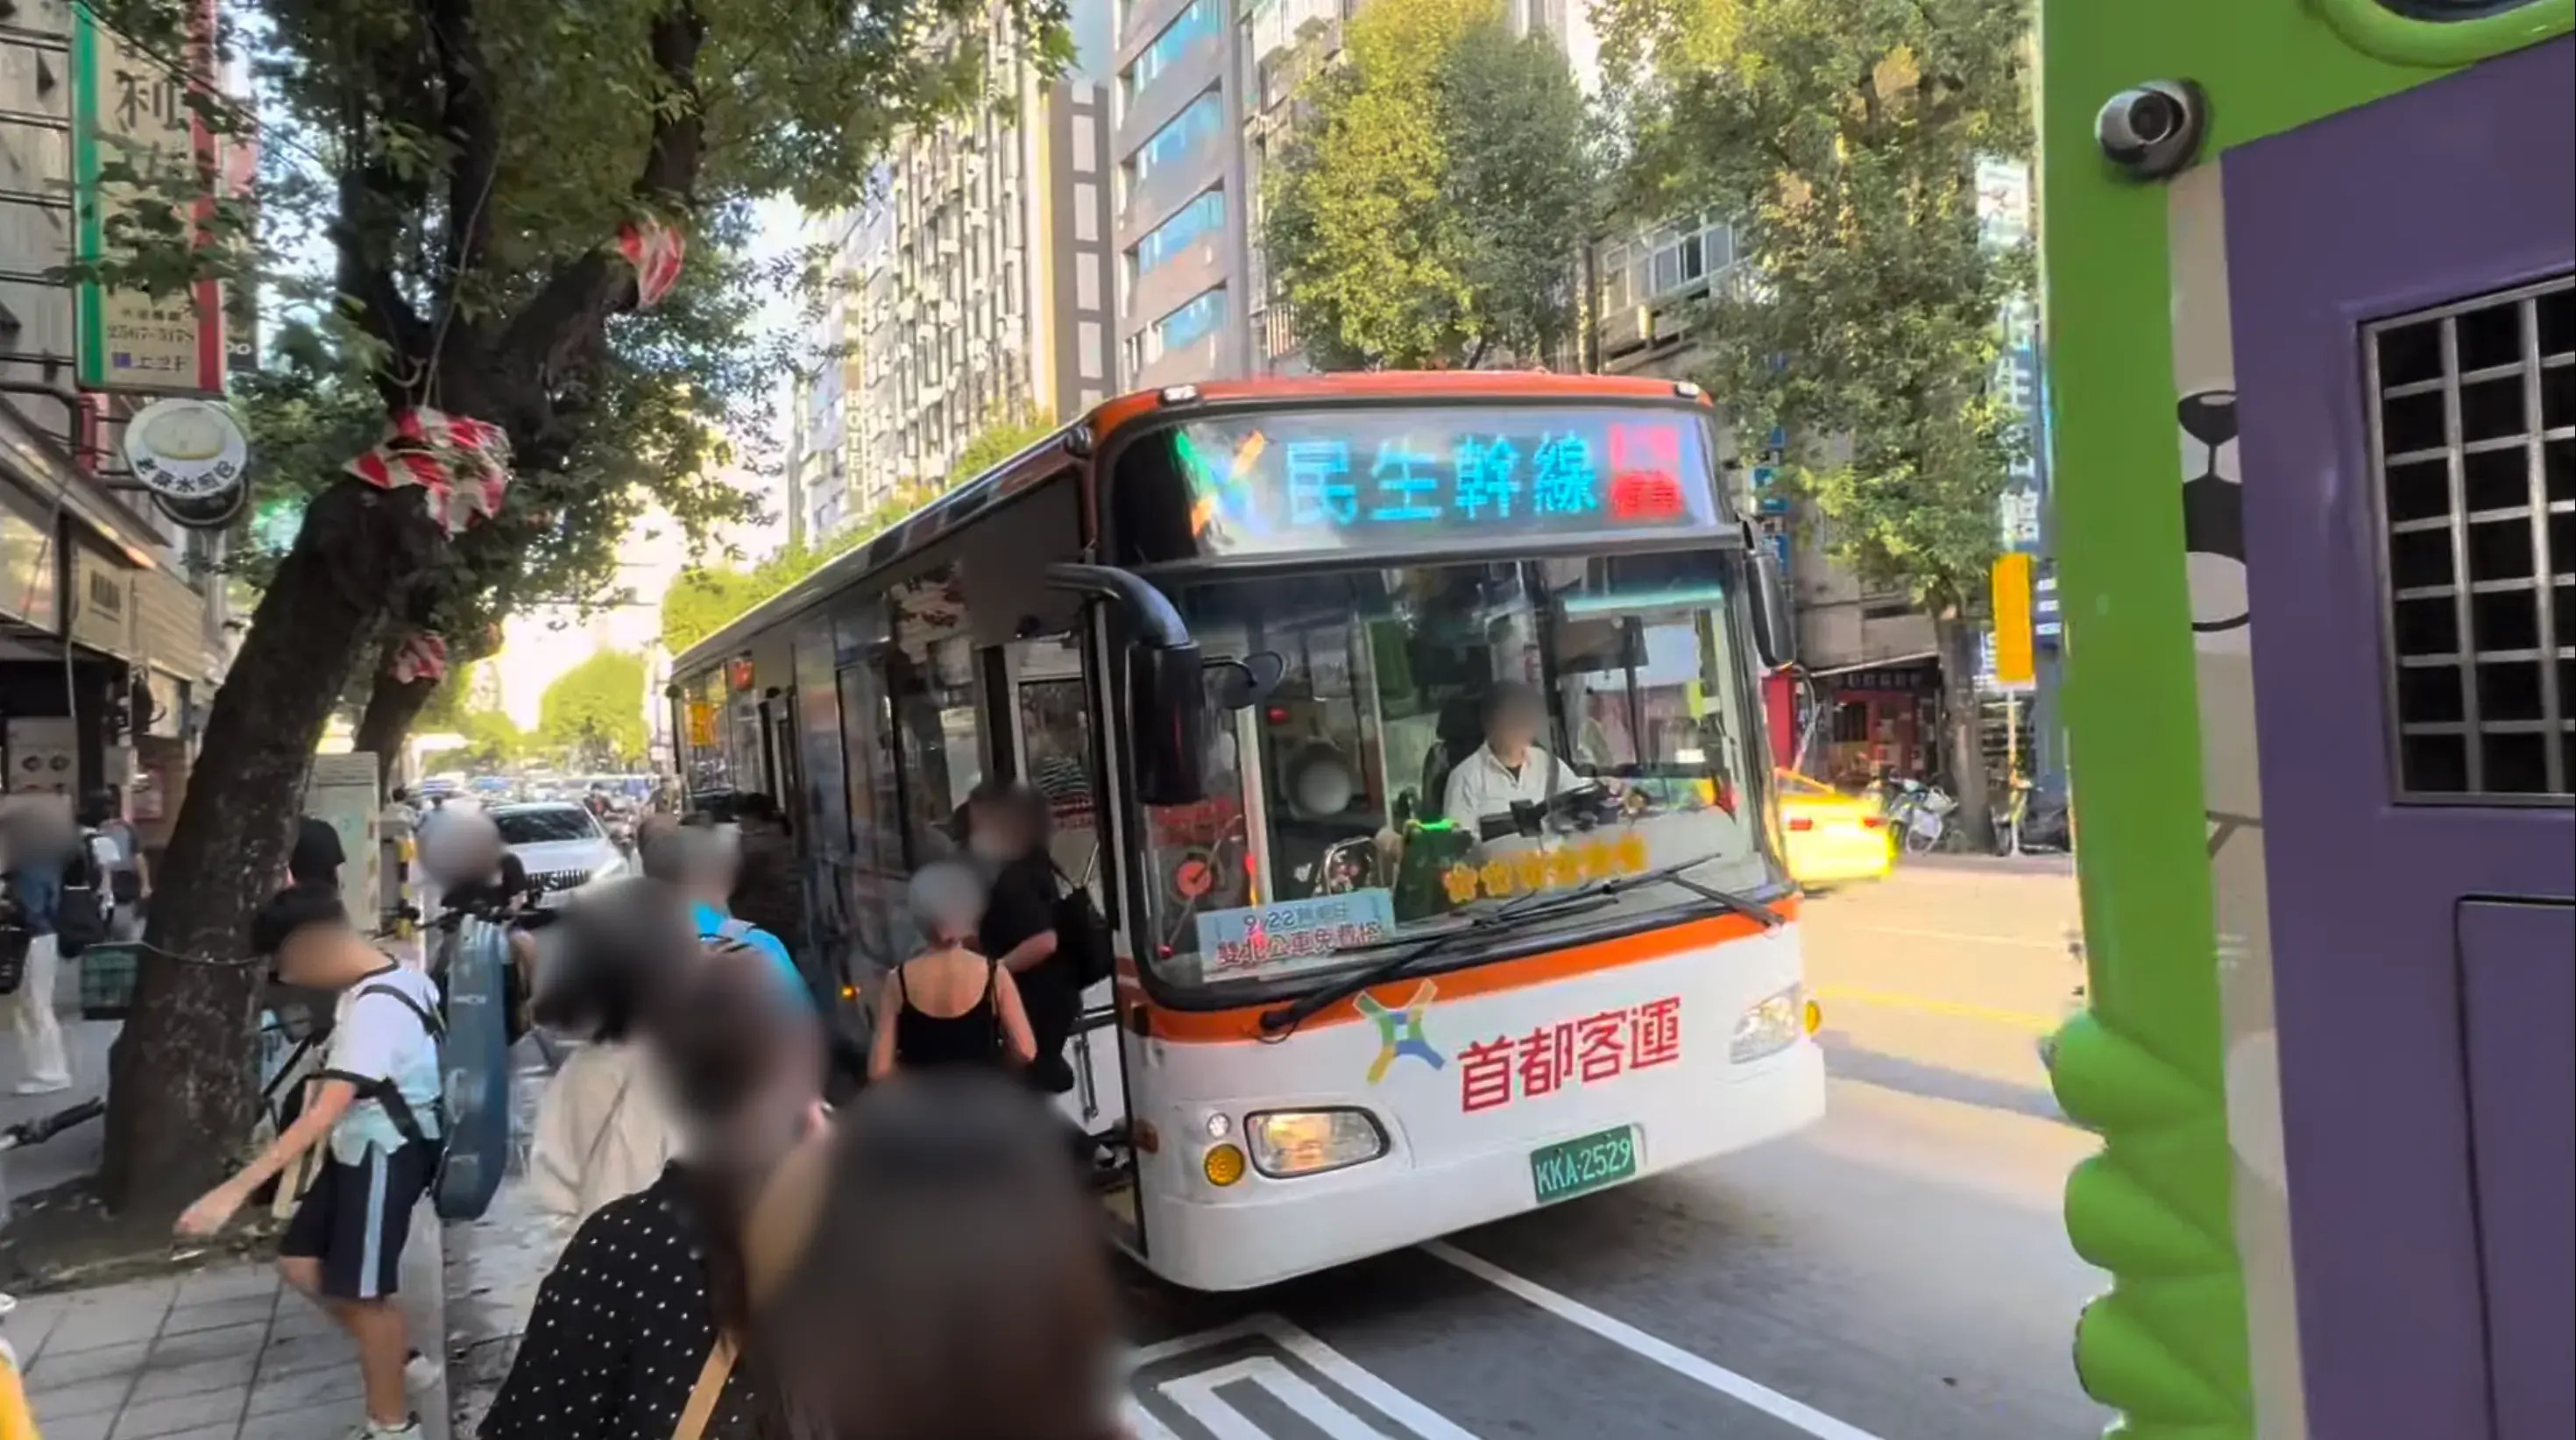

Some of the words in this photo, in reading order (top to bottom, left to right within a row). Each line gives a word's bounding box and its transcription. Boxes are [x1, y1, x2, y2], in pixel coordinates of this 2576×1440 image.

[1286, 430, 1597, 526] 民生幹線
[1457, 996, 1681, 1112] 首都客運
[1535, 1139, 1631, 1195] KKA-2529
